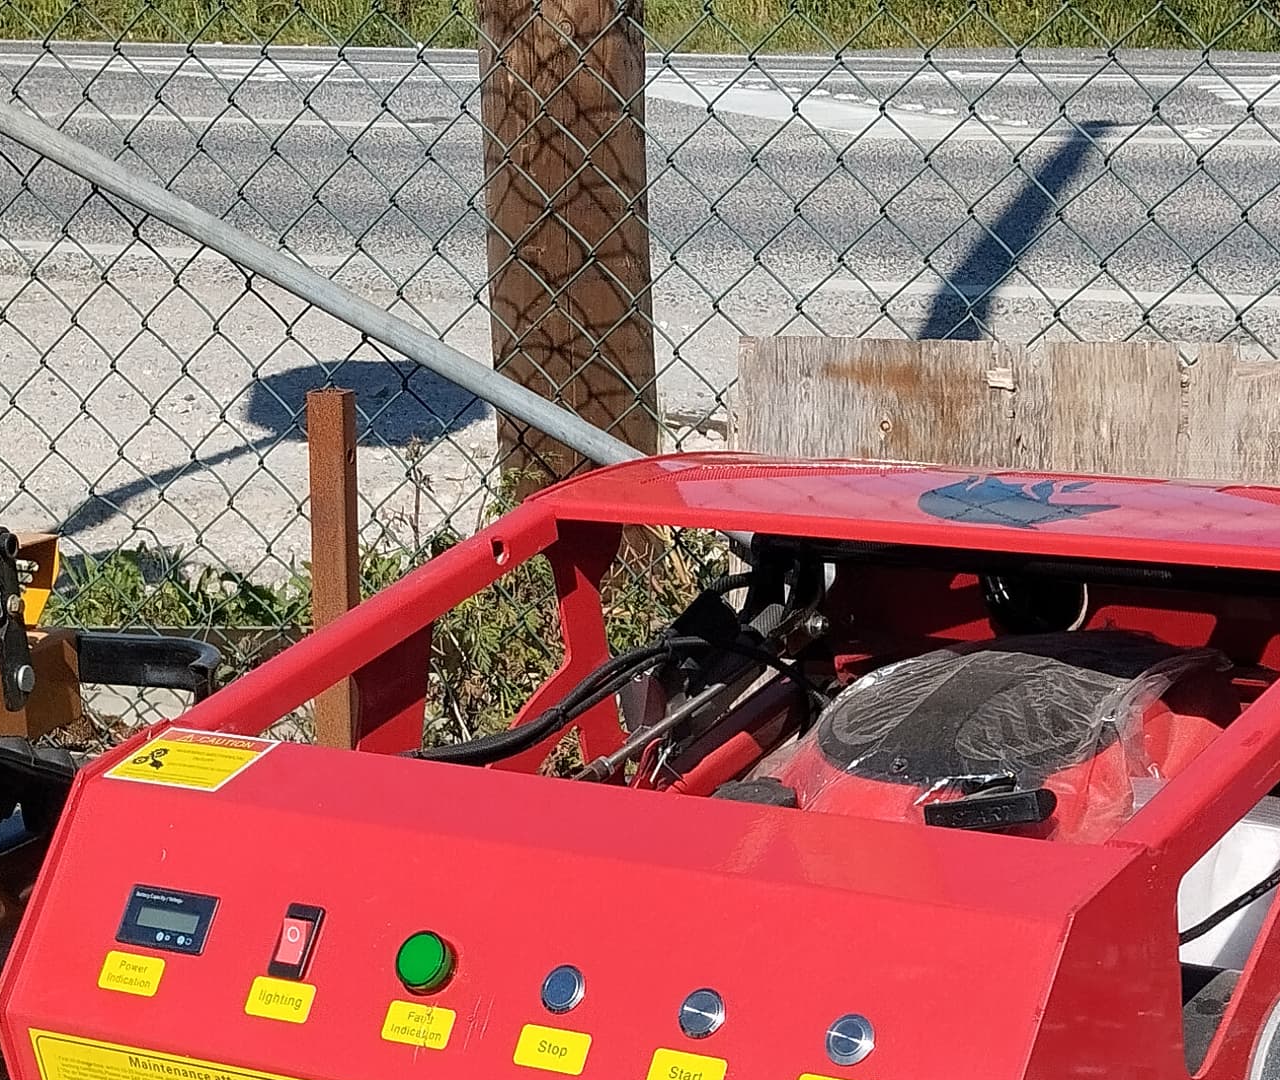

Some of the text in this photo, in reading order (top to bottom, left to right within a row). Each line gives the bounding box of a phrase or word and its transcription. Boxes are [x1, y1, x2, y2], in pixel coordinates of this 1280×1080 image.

[198, 736, 255, 749] CAUTION
[119, 959, 148, 974] Power
[106, 973, 151, 989] Indication
[259, 989, 303, 1010] lighting
[537, 1040, 568, 1059] Stop
